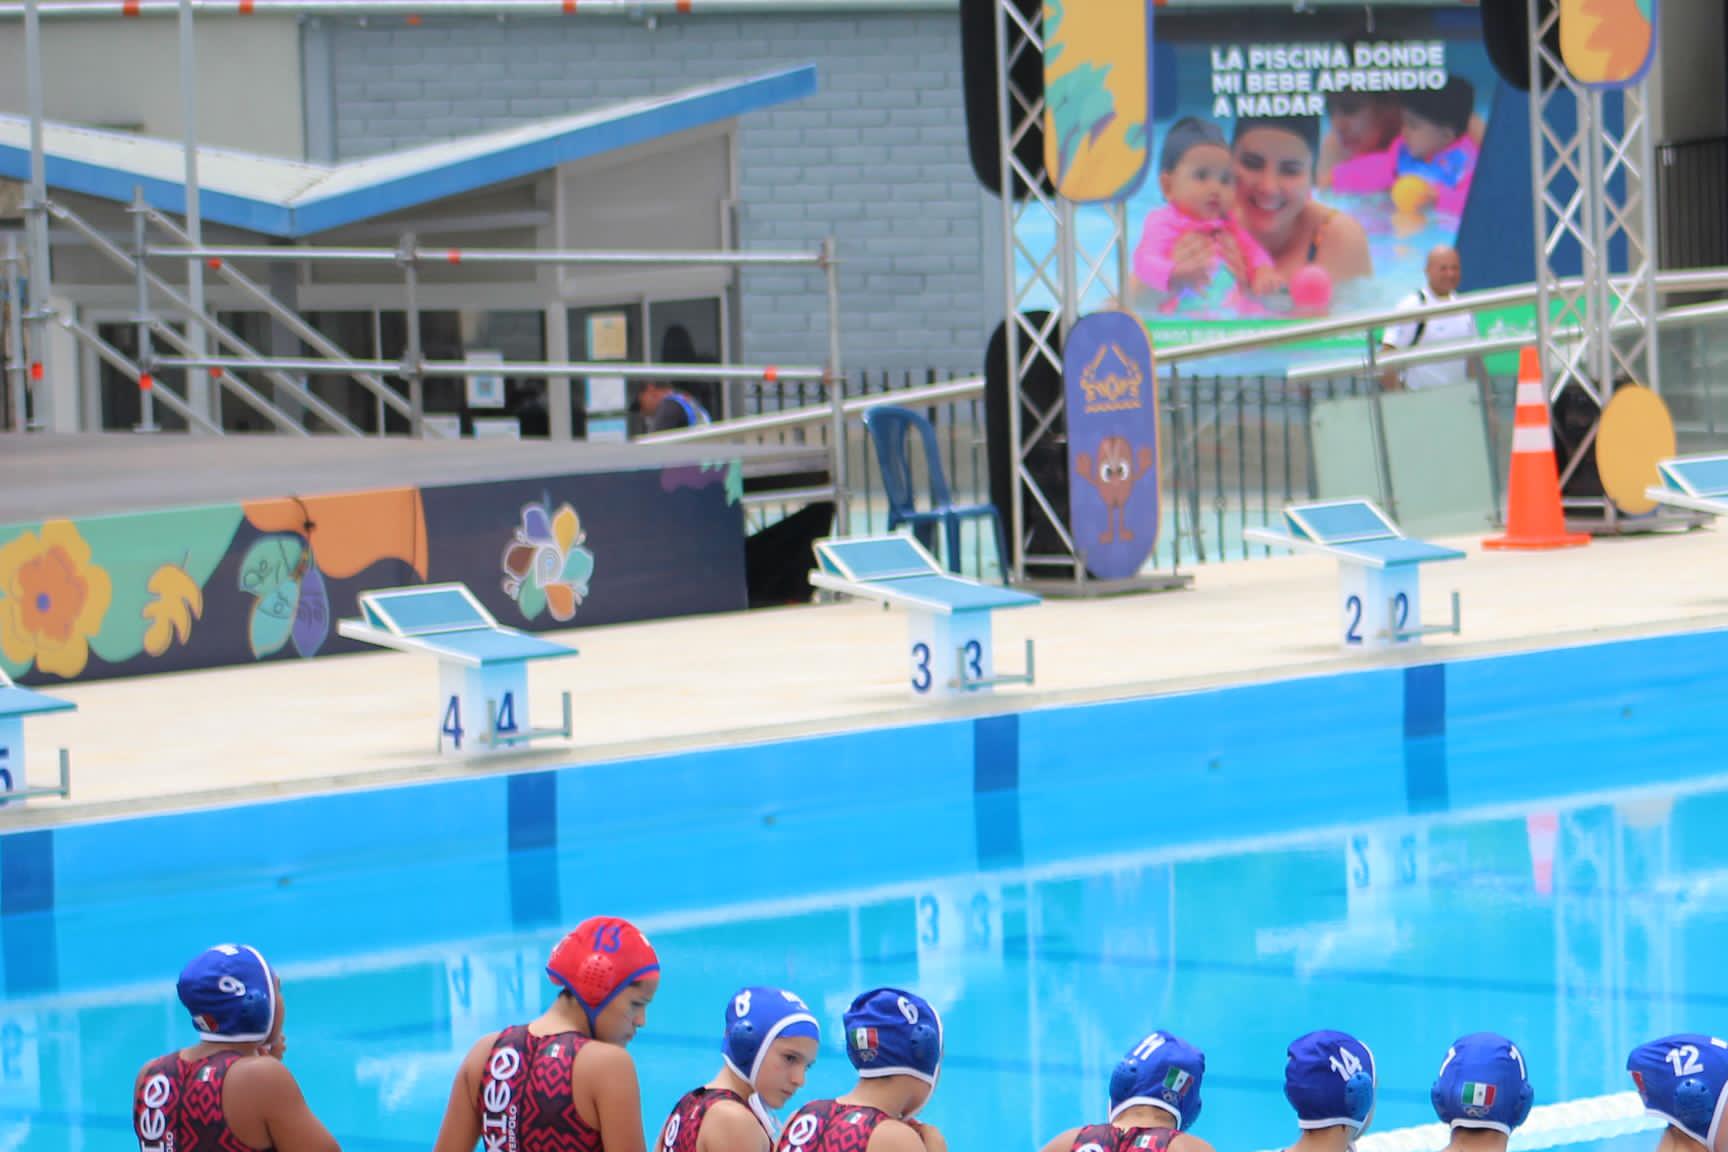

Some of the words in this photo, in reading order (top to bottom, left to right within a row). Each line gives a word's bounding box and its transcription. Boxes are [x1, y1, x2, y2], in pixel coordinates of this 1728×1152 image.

[1210, 46, 1243, 71] LA
[1249, 45, 1348, 70] PISCINA
[1353, 43, 1445, 68] DONDE
[1211, 71, 1241, 94] MI
[1246, 70, 1312, 93] BEBE
[1316, 69, 1448, 92] APRENDIO
[1213, 95, 1231, 117] A
[1235, 94, 1326, 117] NADAR
[1345, 594, 1363, 645] 2
[911, 641, 932, 694] 3
[964, 639, 983, 690] 3
[442, 694, 465, 750] 4
[495, 691, 519, 746] 4
[592, 924, 622, 954] 13
[218, 974, 246, 997] 9
[734, 988, 751, 1018] 8
[896, 996, 919, 1025] 6
[1131, 1032, 1166, 1061] 11
[1665, 1045, 1705, 1078] 12
[1328, 1045, 1364, 1081] 14
